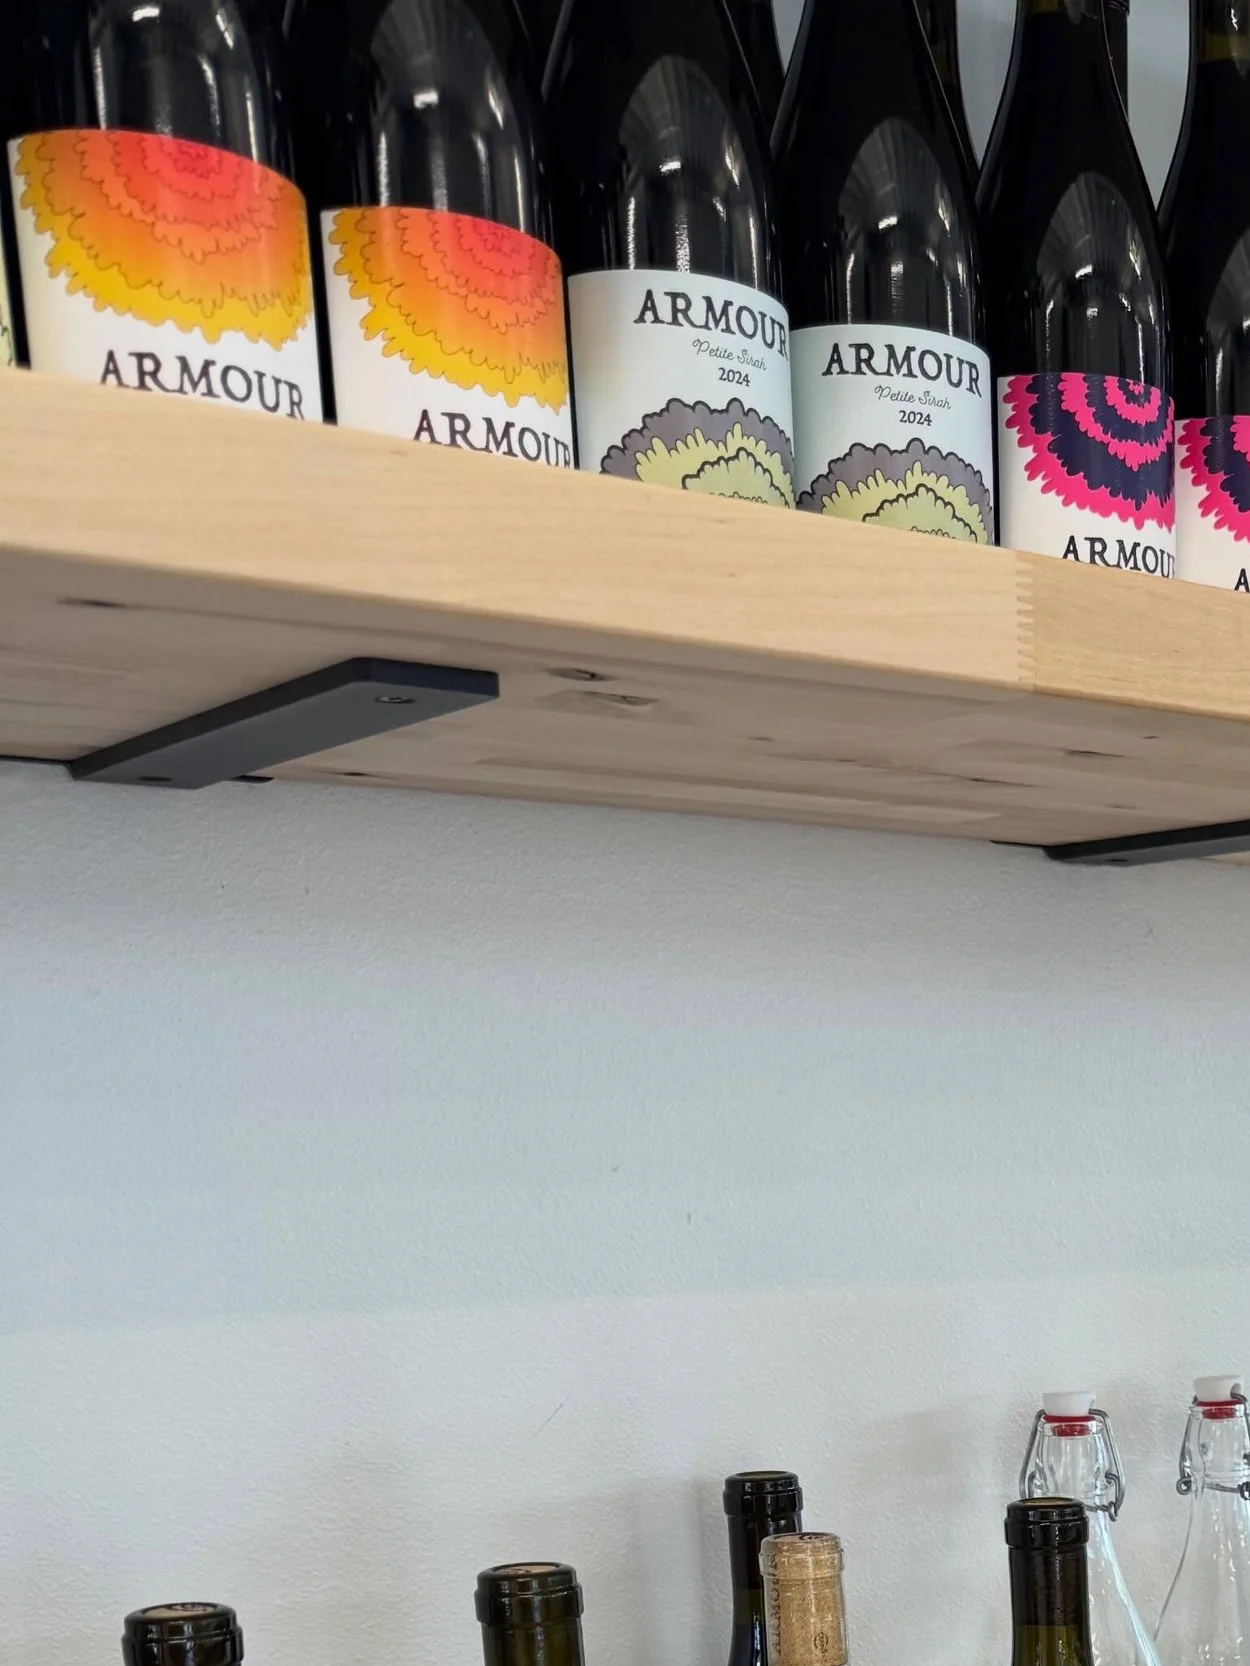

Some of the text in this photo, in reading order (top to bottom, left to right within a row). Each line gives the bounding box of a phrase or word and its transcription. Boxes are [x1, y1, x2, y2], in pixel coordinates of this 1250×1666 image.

[634, 288, 789, 362] ARMOUR
[692, 338, 767, 371] Petite Sirah
[822, 342, 983, 398] ARMOUR
[100, 348, 305, 420] ARMOUR
[718, 367, 751, 387] 2024
[874, 384, 951, 410] Petite Sirah
[413, 408, 571, 468] ARMOUR
[899, 410, 933, 426] 2024
